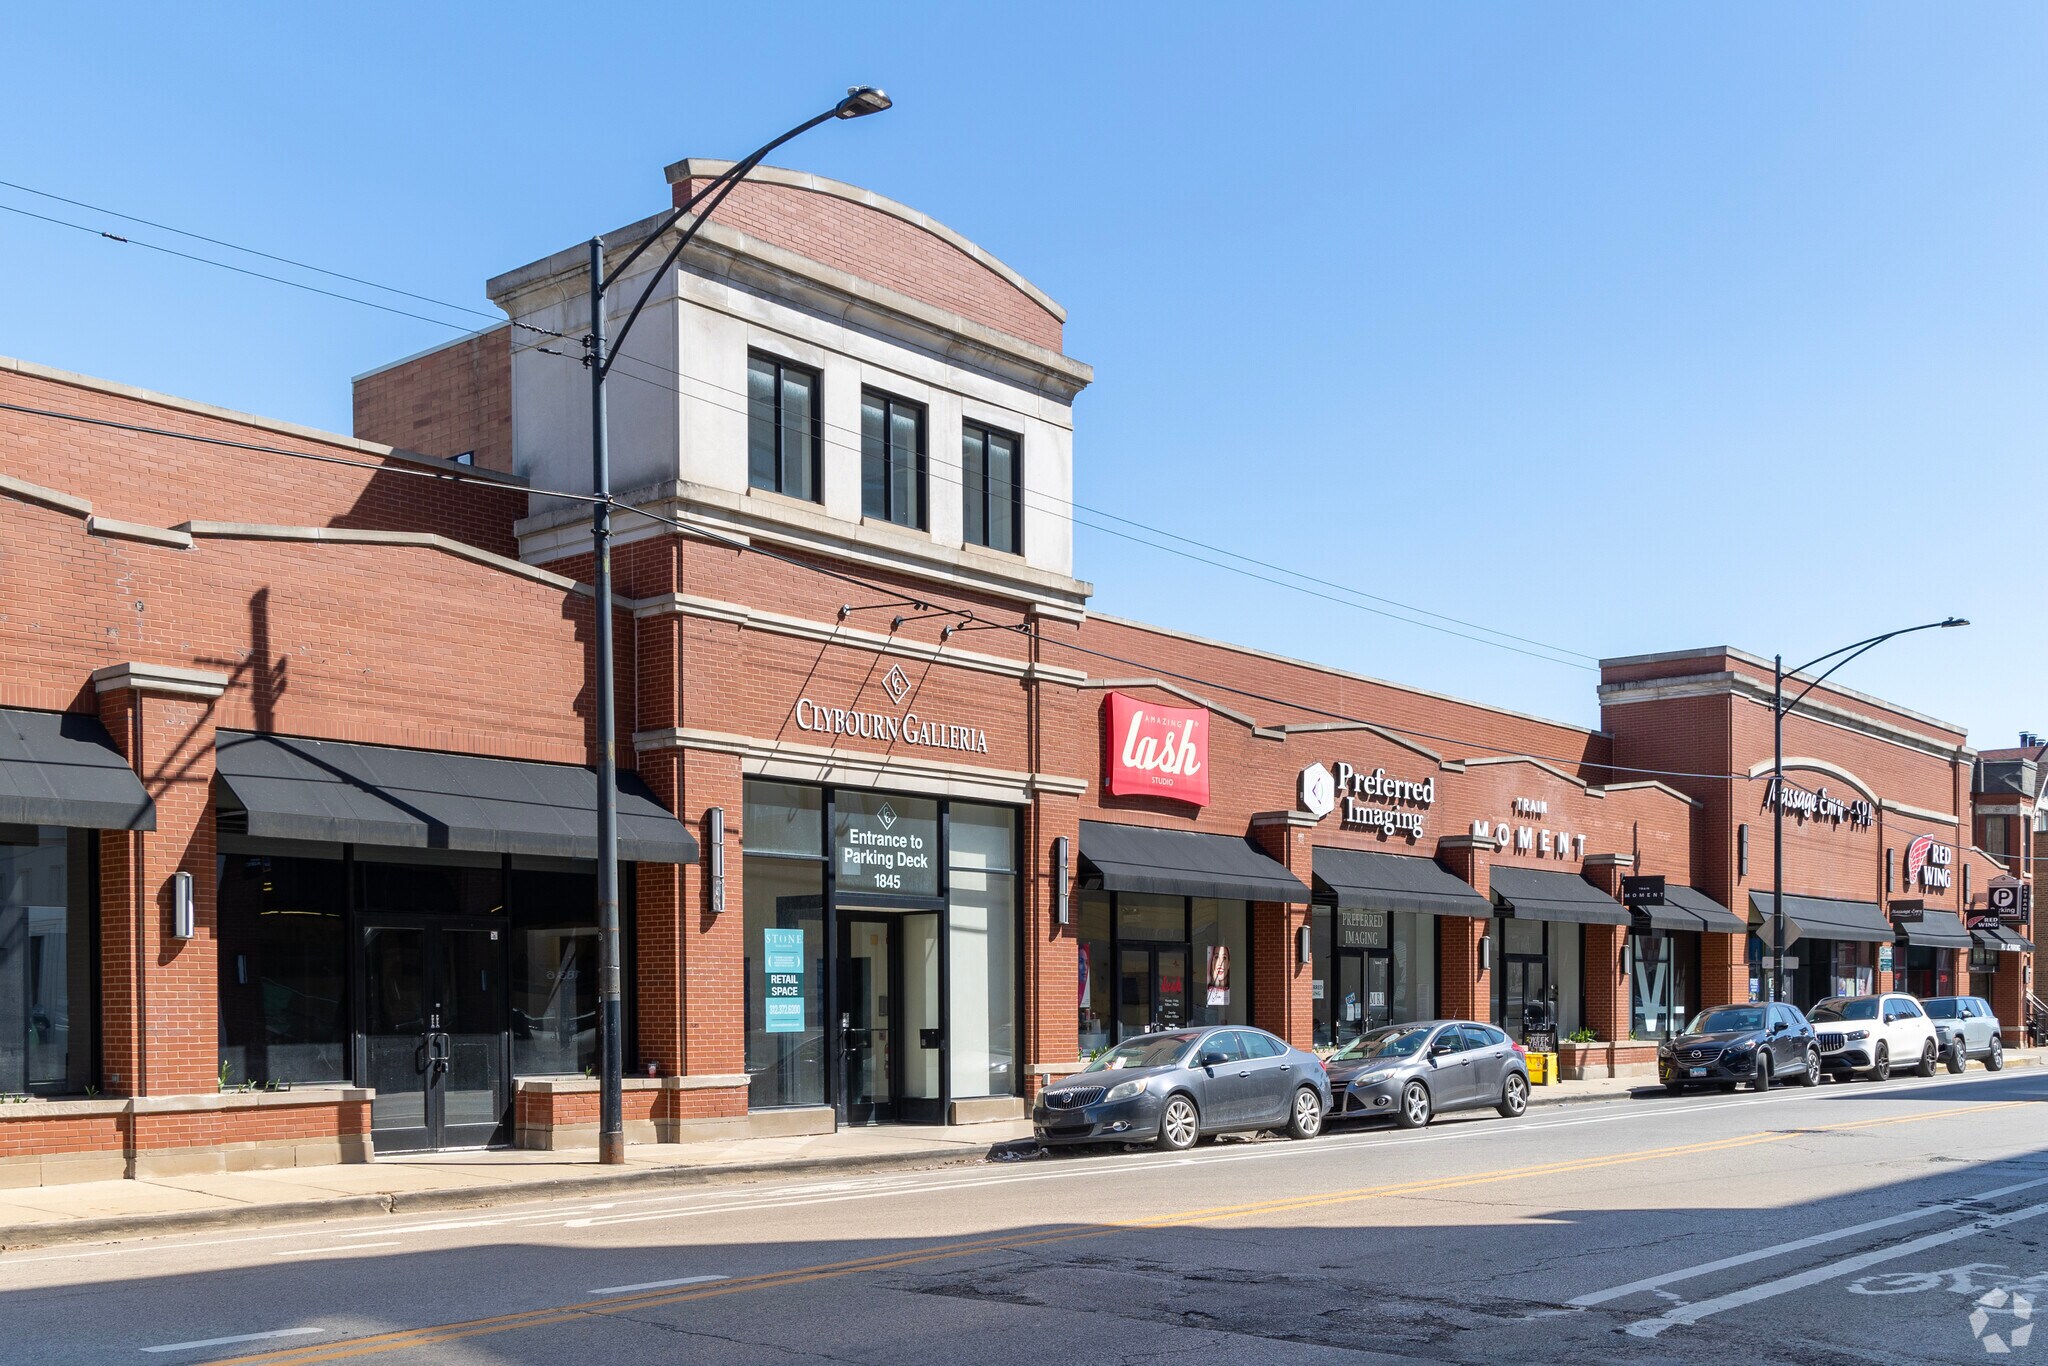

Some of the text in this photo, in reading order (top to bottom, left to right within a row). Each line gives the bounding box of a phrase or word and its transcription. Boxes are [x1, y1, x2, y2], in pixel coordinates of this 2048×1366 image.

[796, 698, 988, 753] CLYBOURN GALLERIA
[1145, 716, 1182, 728] AMAZING
[1122, 710, 1201, 776] lash
[1151, 776, 1174, 786] STUDIO
[1338, 762, 1436, 803] Preferred
[1517, 797, 1548, 814] TRAIN
[1819, 787, 1844, 824] Envy
[1856, 800, 1873, 826] SPA
[1346, 796, 1424, 839] Imaging
[850, 828, 923, 849] Entrance to
[1474, 819, 1586, 856] MOMENT
[844, 847, 928, 869] Parking Deck
[1932, 844, 1952, 865] RED
[874, 873, 901, 889] 1845
[1923, 865, 1951, 888] WING
[1342, 912, 1384, 928] PREFERRED
[765, 934, 803, 944] STONE
[1345, 930, 1379, 945] IMAGING
[770, 974, 799, 984] RETAIL
[771, 986, 798, 996] SPACE
